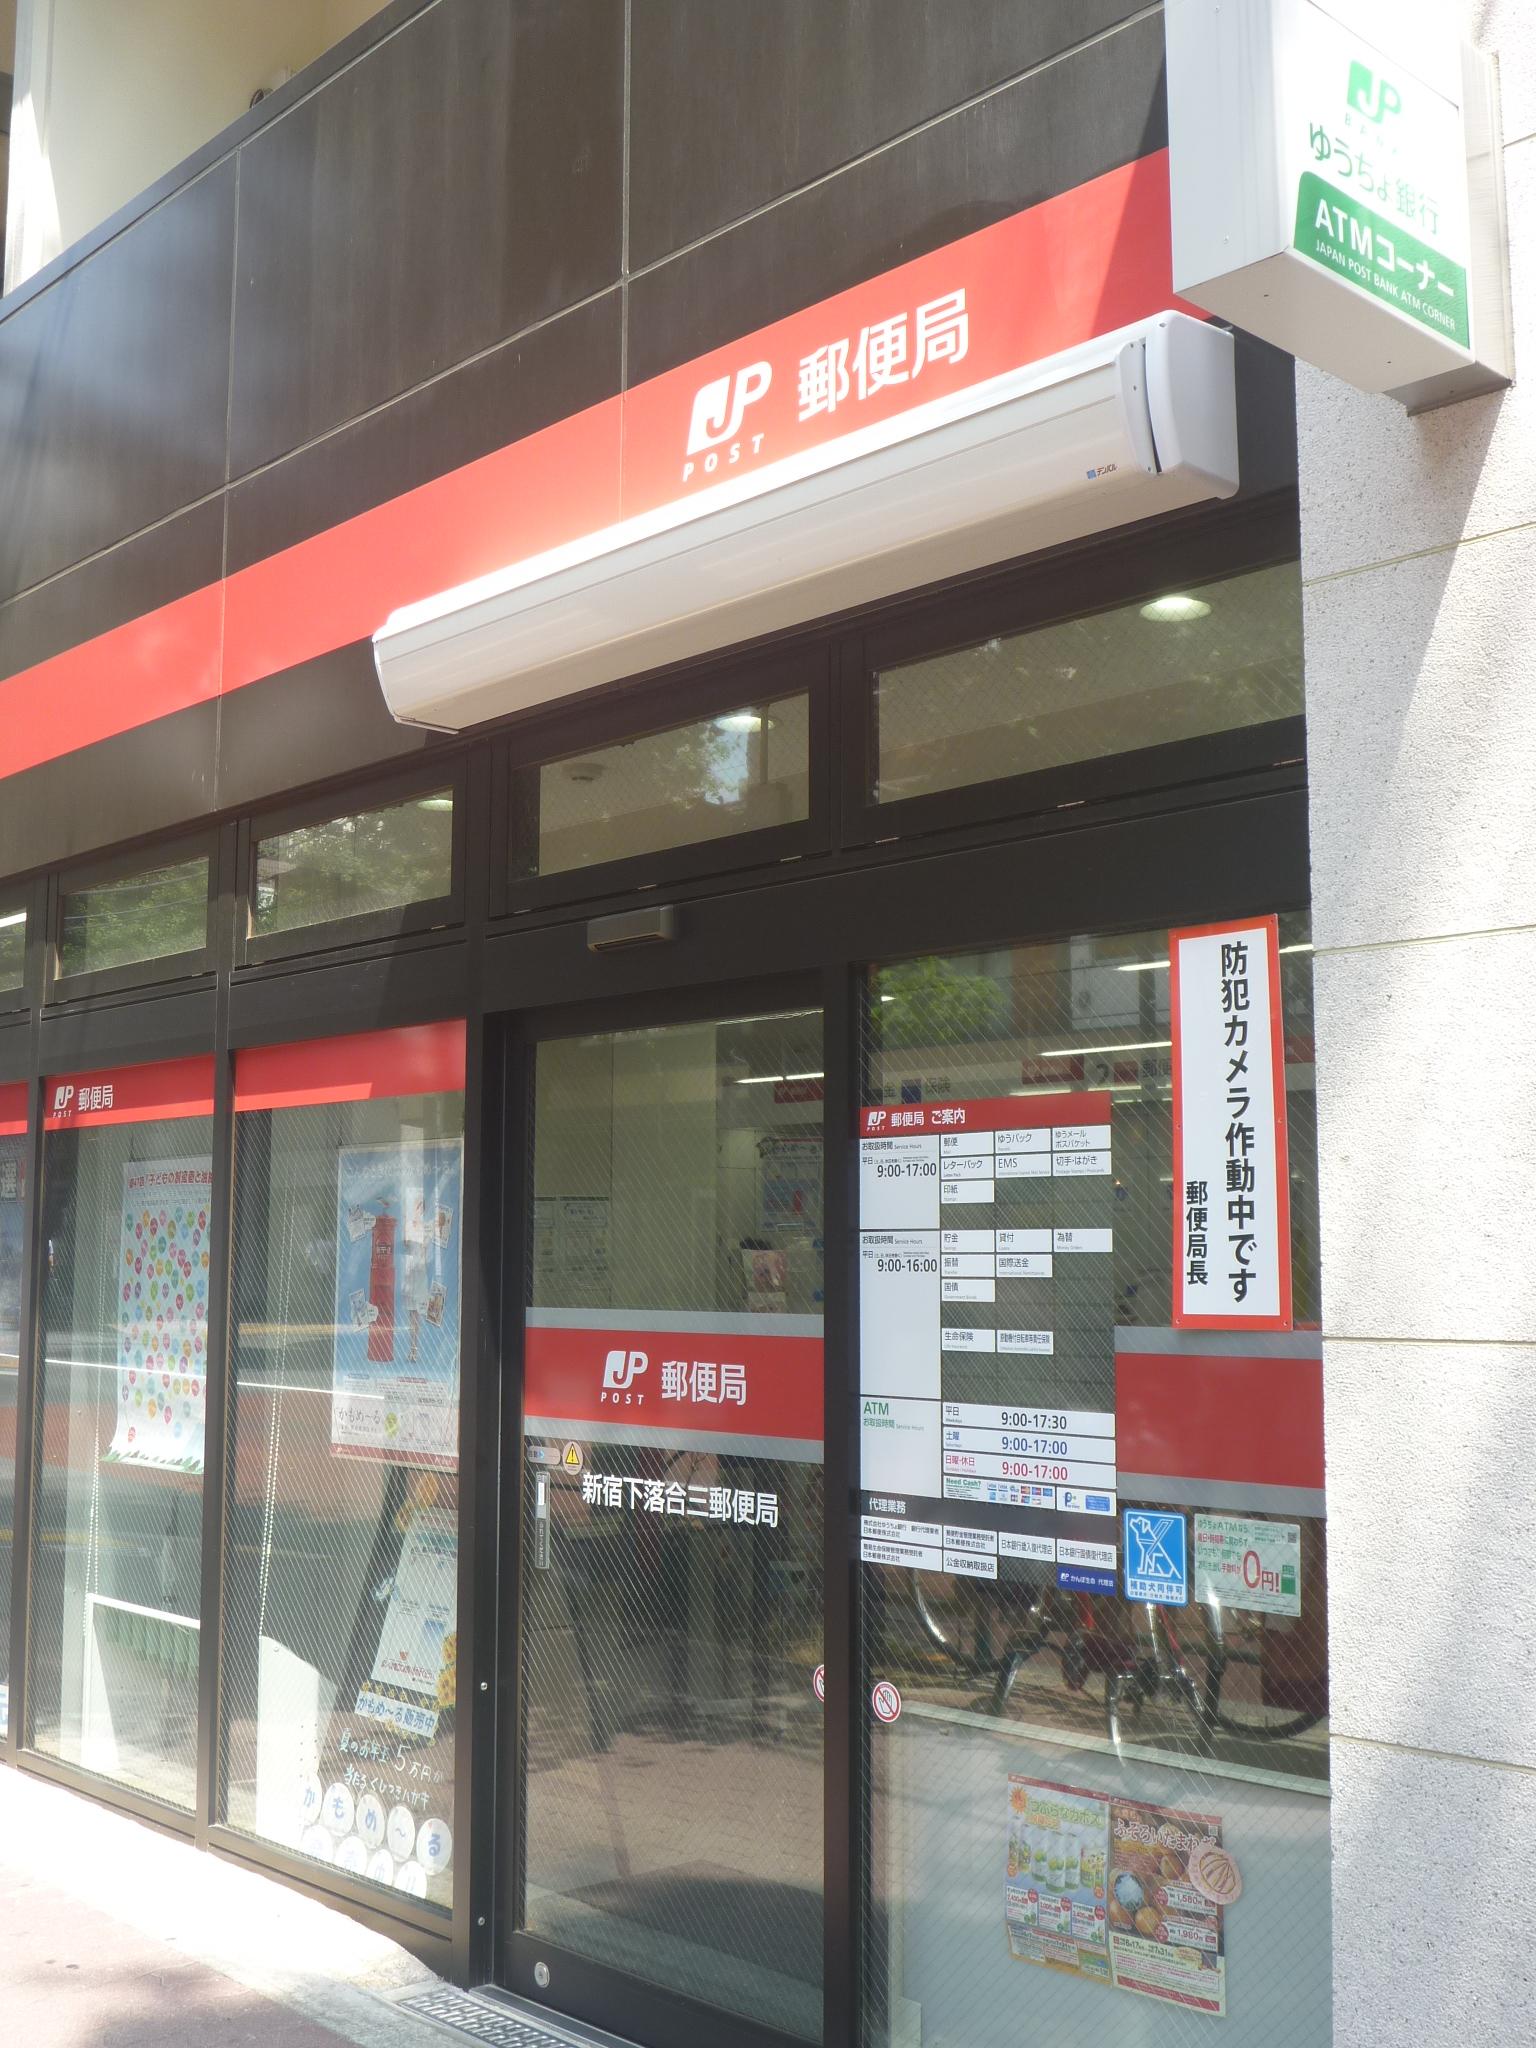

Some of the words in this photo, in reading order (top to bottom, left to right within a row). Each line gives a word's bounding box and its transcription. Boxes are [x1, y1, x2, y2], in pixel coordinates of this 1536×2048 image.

[1309, 122, 1439, 235] ゆうちょ銀行
[1315, 199, 1454, 297] ATMコーナー
[1316, 239, 1346, 268] JAPAN
[1348, 255, 1371, 281] POST
[1374, 270, 1398, 297] BANK
[1400, 285, 1421, 311] ATM
[1422, 296, 1456, 332] CORNER
[798, 288, 969, 422] 郵便局
[683, 433, 765, 482] POST
[78, 1085, 113, 1112] 郵便局
[891, 1112, 925, 1127] 郵便局
[931, 1108, 966, 1126] ご案内
[1220, 942, 1258, 1303] 防犯カメラ作動中です
[1055, 1130, 1087, 1139] ゆうメール
[877, 1163, 937, 1178] 9:00-17:00
[998, 1158, 1018, 1169] EMS
[944, 1232, 959, 1243] 貯金
[1186, 1180, 1209, 1286] 郵便局長
[877, 1259, 938, 1272] 9:00-16:00
[999, 1258, 1029, 1268] 国際送金
[945, 1331, 974, 1342] 生命保険
[661, 1360, 748, 1406] 郵便局
[600, 1392, 645, 1406] POST
[863, 1401, 889, 1416] ATM
[945, 1405, 960, 1416] 平日
[1001, 1411, 1068, 1431] 9:00-17:30
[945, 1431, 960, 1441] 土曜
[1001, 1436, 1068, 1456] 9:00-17:00
[1002, 1461, 1068, 1481] 9:00-17:00
[946, 1477, 961, 1486] Need
[963, 1479, 982, 1488] Cash?
[582, 1471, 779, 1528] 新宿下落合三郵便局
[869, 1497, 906, 1514] 代理業務
[946, 1557, 994, 1573] 公金収納取扱店
